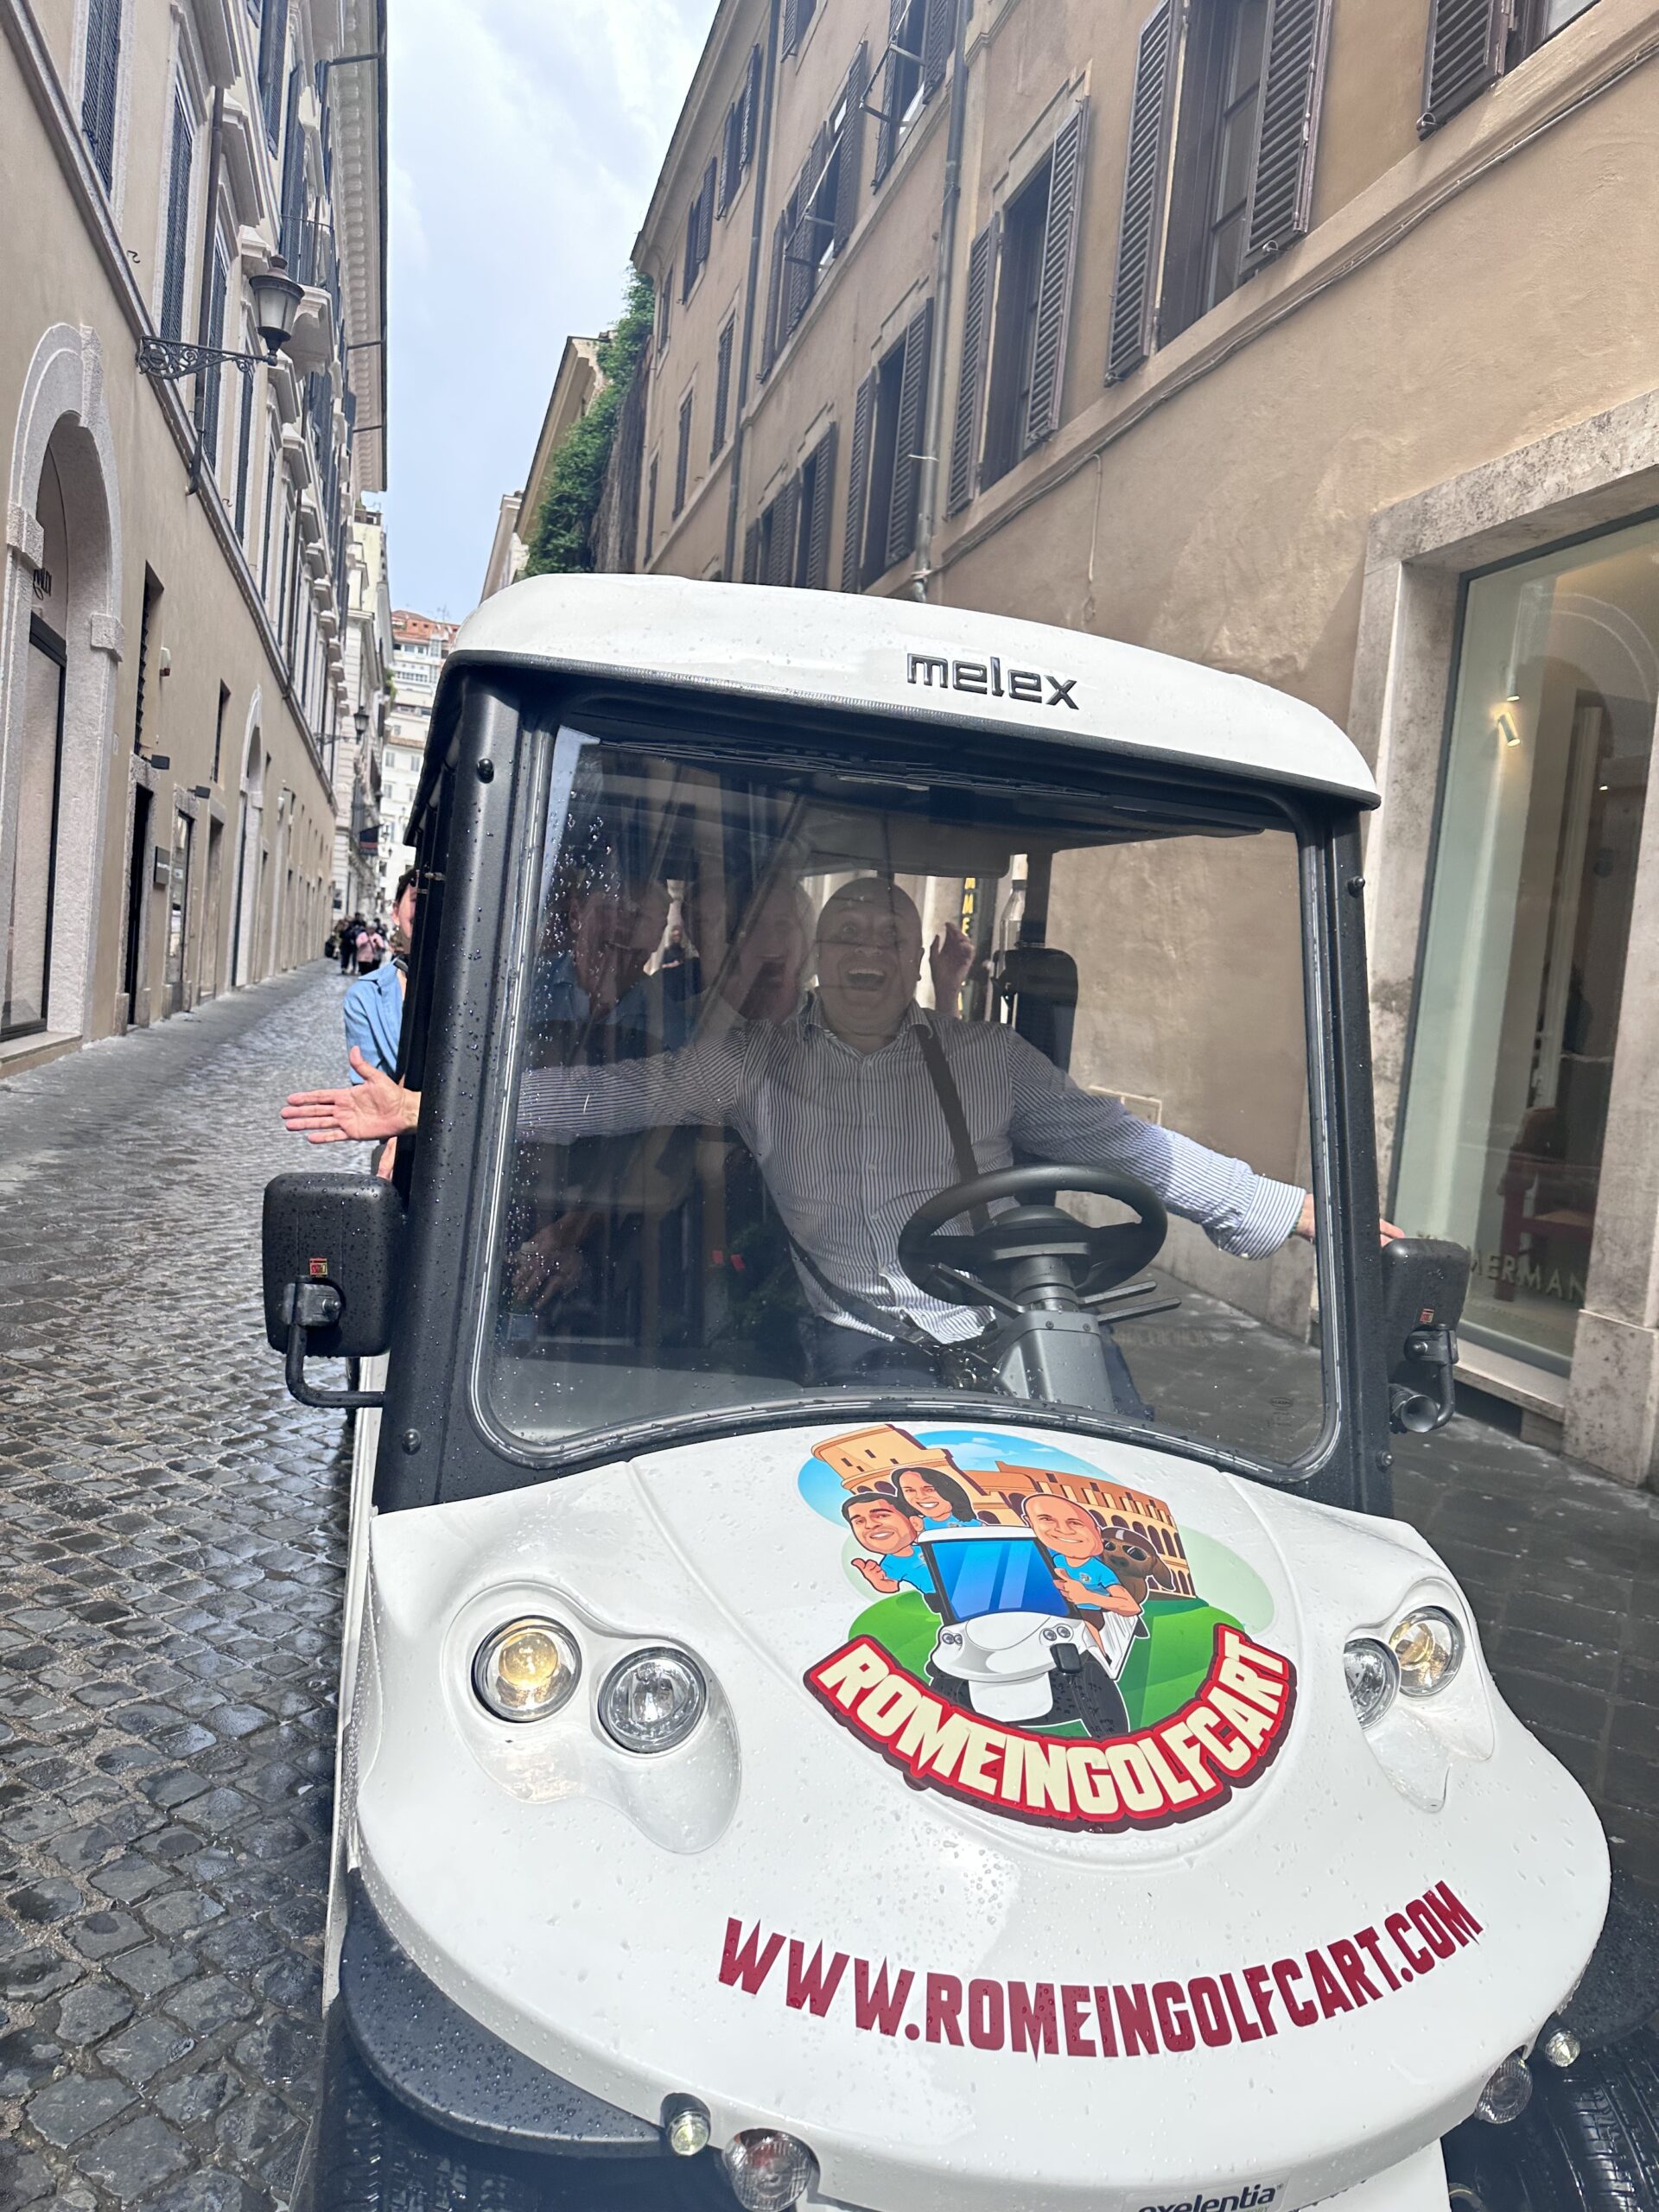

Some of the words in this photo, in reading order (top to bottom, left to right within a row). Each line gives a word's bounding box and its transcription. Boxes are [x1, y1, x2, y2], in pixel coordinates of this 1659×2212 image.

[907, 653, 1079, 710] melex
[810, 1625, 1287, 1814] ROMEINGOLFCART
[718, 1880, 1483, 2060] WWW.ROMEINGOLFCART.COM
